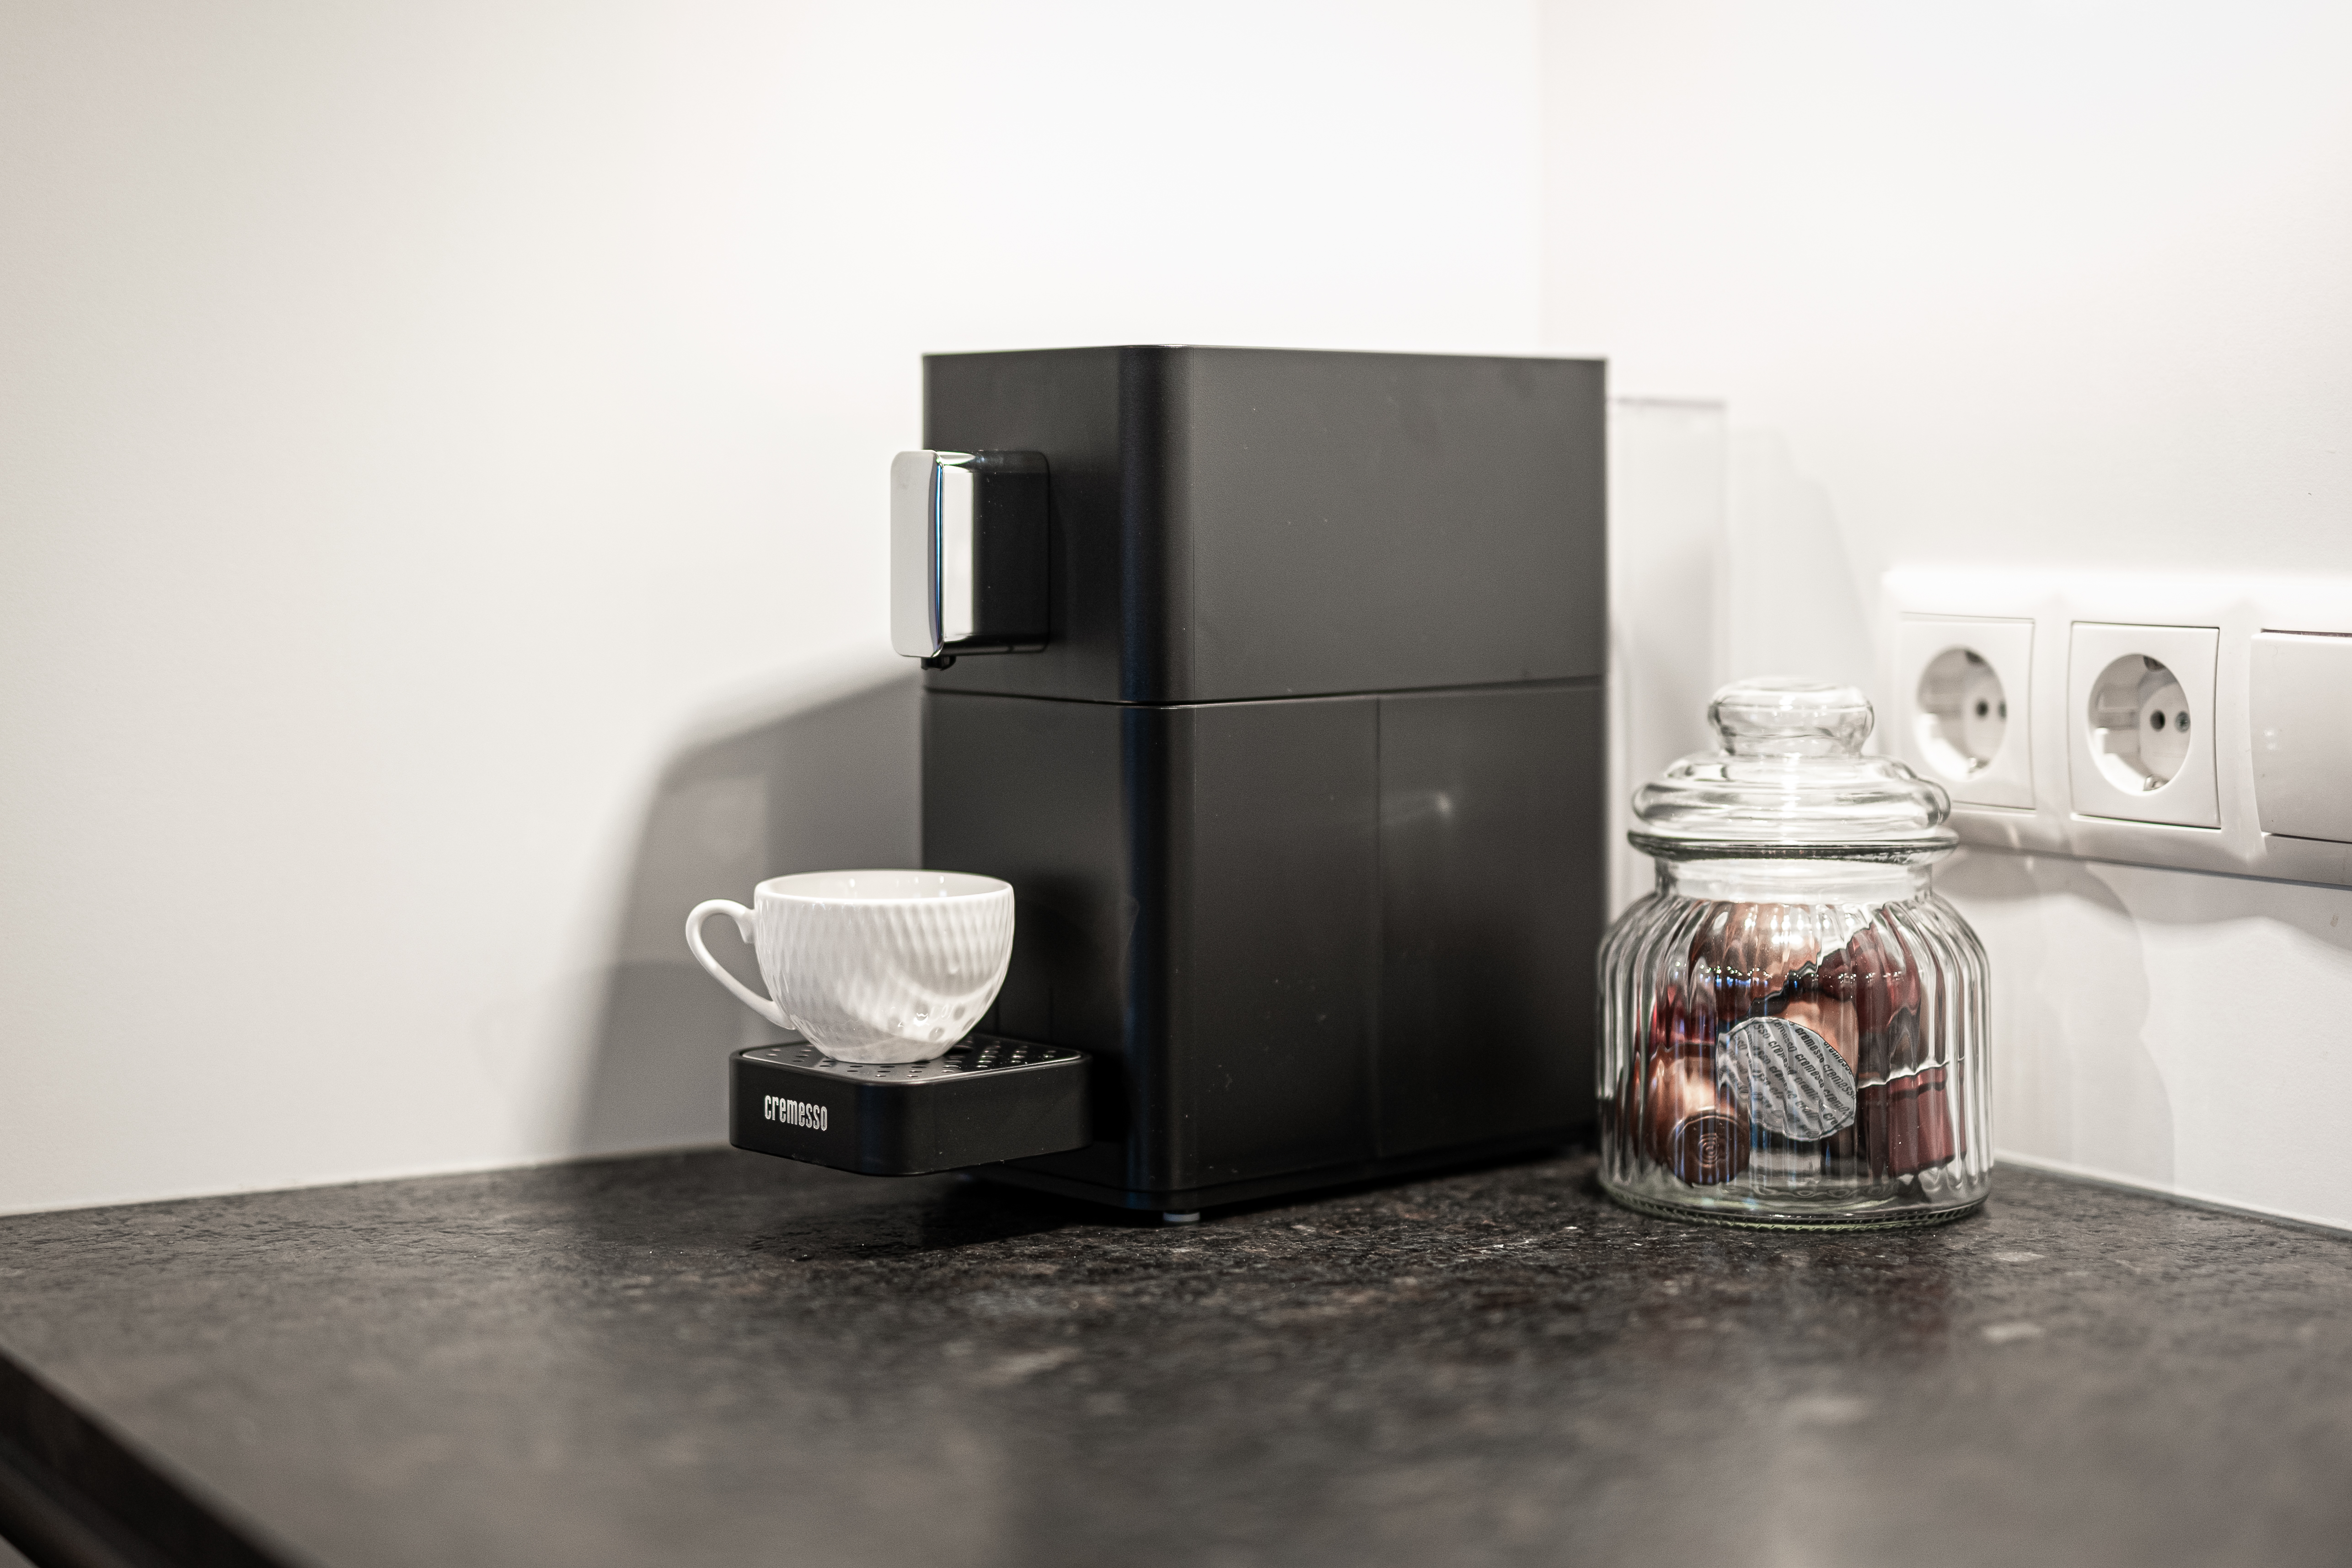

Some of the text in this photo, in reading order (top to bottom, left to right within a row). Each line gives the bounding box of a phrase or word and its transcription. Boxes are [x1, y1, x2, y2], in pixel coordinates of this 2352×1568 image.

[1795, 1028, 1824, 1063] cremesso
[1795, 1054, 1825, 1088] cremesso
[765, 1095, 827, 1131] cremesso
